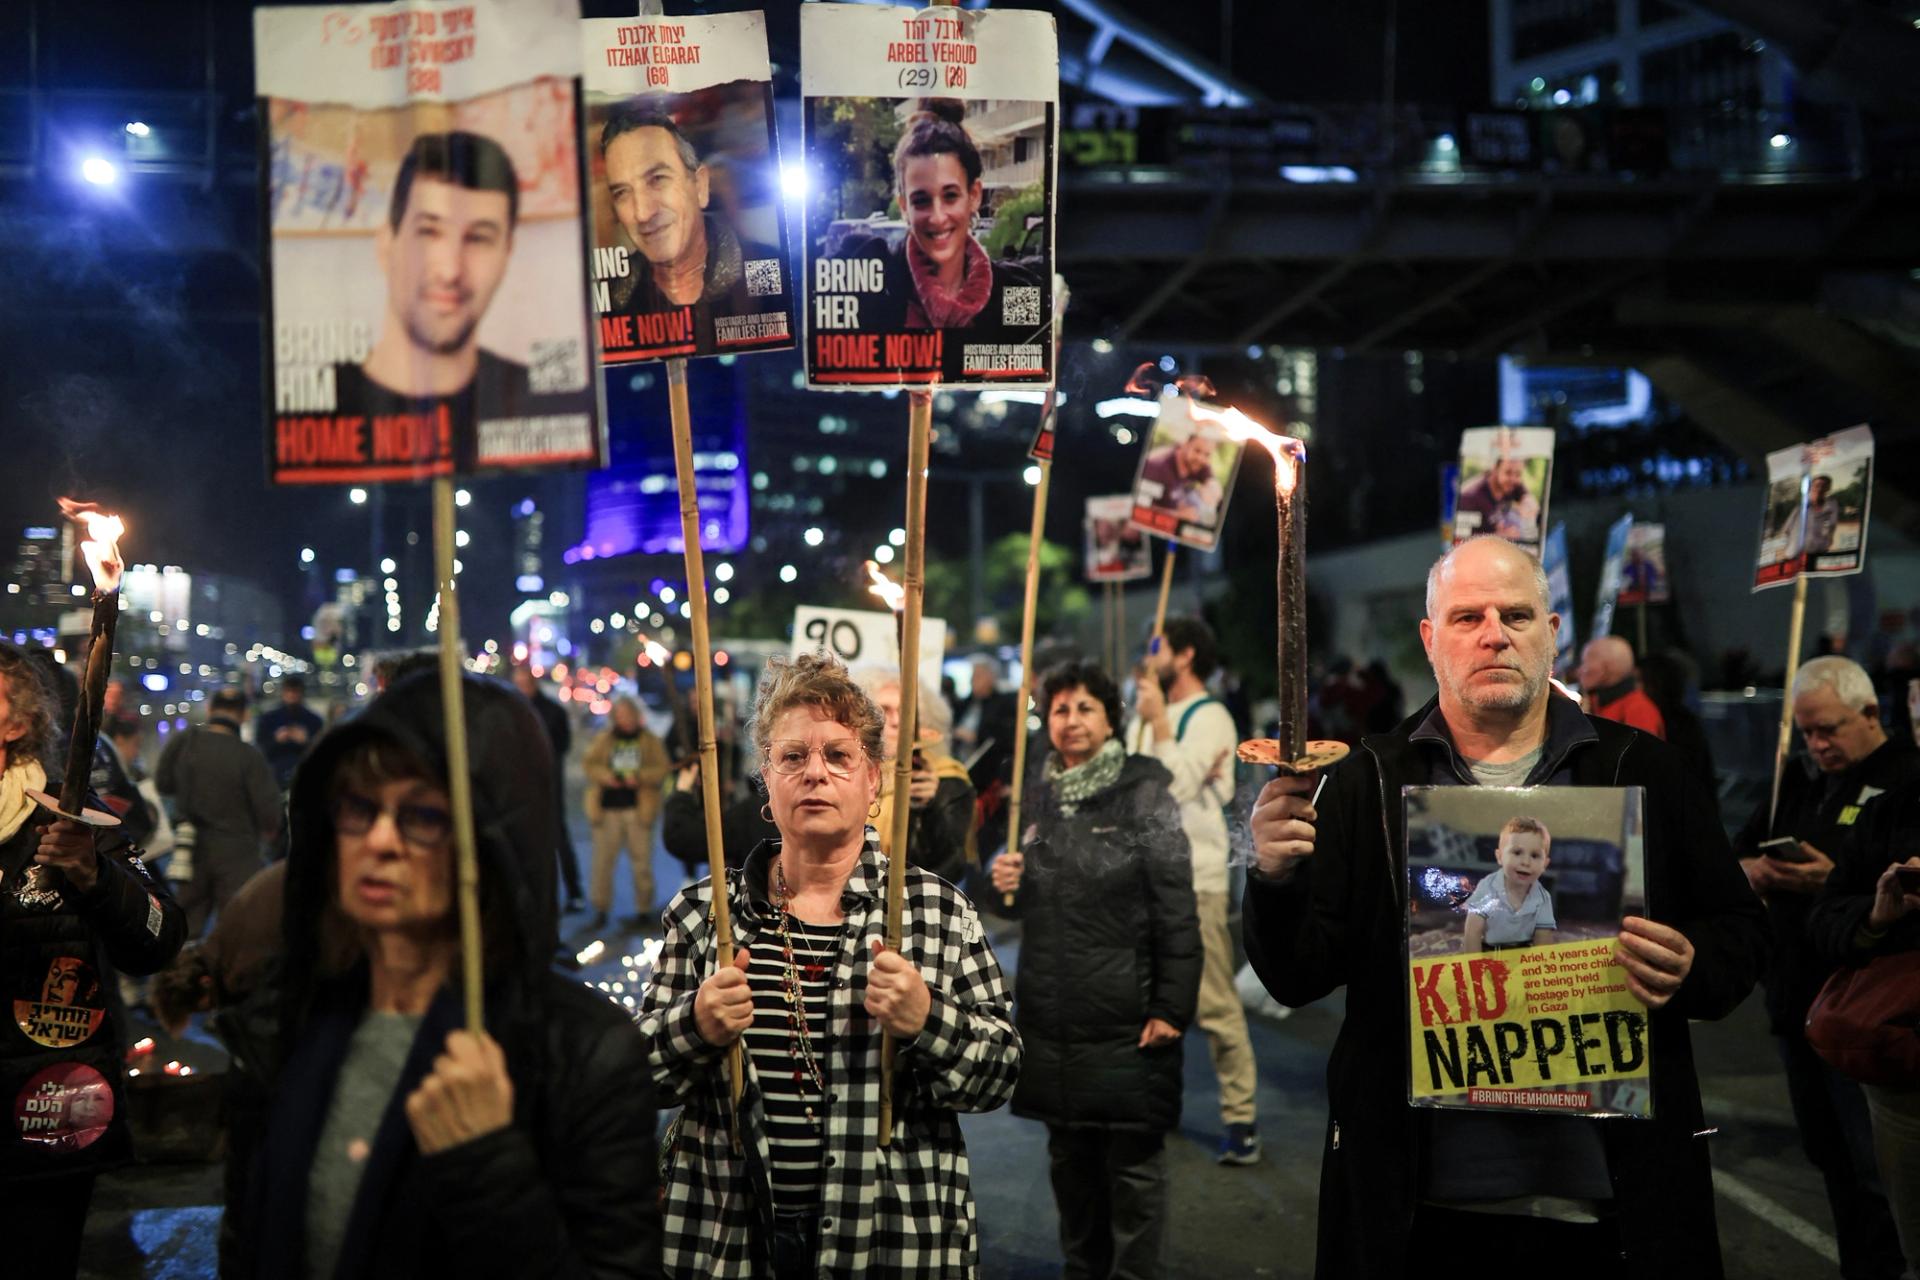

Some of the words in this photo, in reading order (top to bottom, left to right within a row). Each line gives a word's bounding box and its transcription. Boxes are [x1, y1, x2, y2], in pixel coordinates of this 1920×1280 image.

[618, 25, 656, 45] אלגרט
[660, 26, 685, 44] יצחק
[903, 19, 930, 39] יהוד
[934, 18, 964, 40] ארבל
[607, 47, 650, 67] ITZHAK
[653, 46, 700, 64] ELGARAT
[887, 43, 928, 63] ARBEL
[931, 43, 977, 65] YEHOUD
[646, 67, 669, 86] (68)
[899, 67, 938, 89] (29)
[816, 258, 884, 293] BRING
[816, 296, 860, 329] HER
[637, 306, 694, 344] NOW!
[716, 325, 757, 341] FAMILIES
[758, 322, 788, 338] FORUM
[816, 334, 880, 368] HOME
[886, 329, 943, 368] NOW!
[963, 344, 998, 354] HOSTAGES
[999, 344, 1012, 354] AND
[1013, 344, 1043, 354] MISSING
[963, 355, 1006, 370] FAMILIES
[1008, 355, 1043, 370] FORUM
[277, 364, 336, 412] HIM
[276, 415, 365, 464] HOME
[372, 403, 453, 460] NOW!
[1520, 952, 1547, 964] Ariel,
[1549, 951, 1556, 960] 4
[1559, 947, 1589, 961] years
[1591, 945, 1612, 956] old,
[1522, 965, 1542, 976] and
[1545, 963, 1557, 973] 39
[1560, 962, 1588, 972] more
[1524, 979, 1541, 989] are
[1543, 975, 1574, 987] being
[1576, 972, 1600, 983] held
[1413, 958, 1511, 1027] KID
[1525, 990, 1569, 1001] hostage
[1572, 988, 1585, 999] by
[1588, 983, 1626, 995] Hamas
[1528, 1004, 1538, 1014] in
[1541, 1002, 1568, 1013] Gaza
[28, 1018, 89, 1040] ישראל
[1423, 1010, 1648, 1090] NAPPED
[25, 1099, 63, 1113] העם
[1472, 1089, 1588, 1107] #BRINGTHEMHOMENOW
[19, 1116, 60, 1131] איתך
